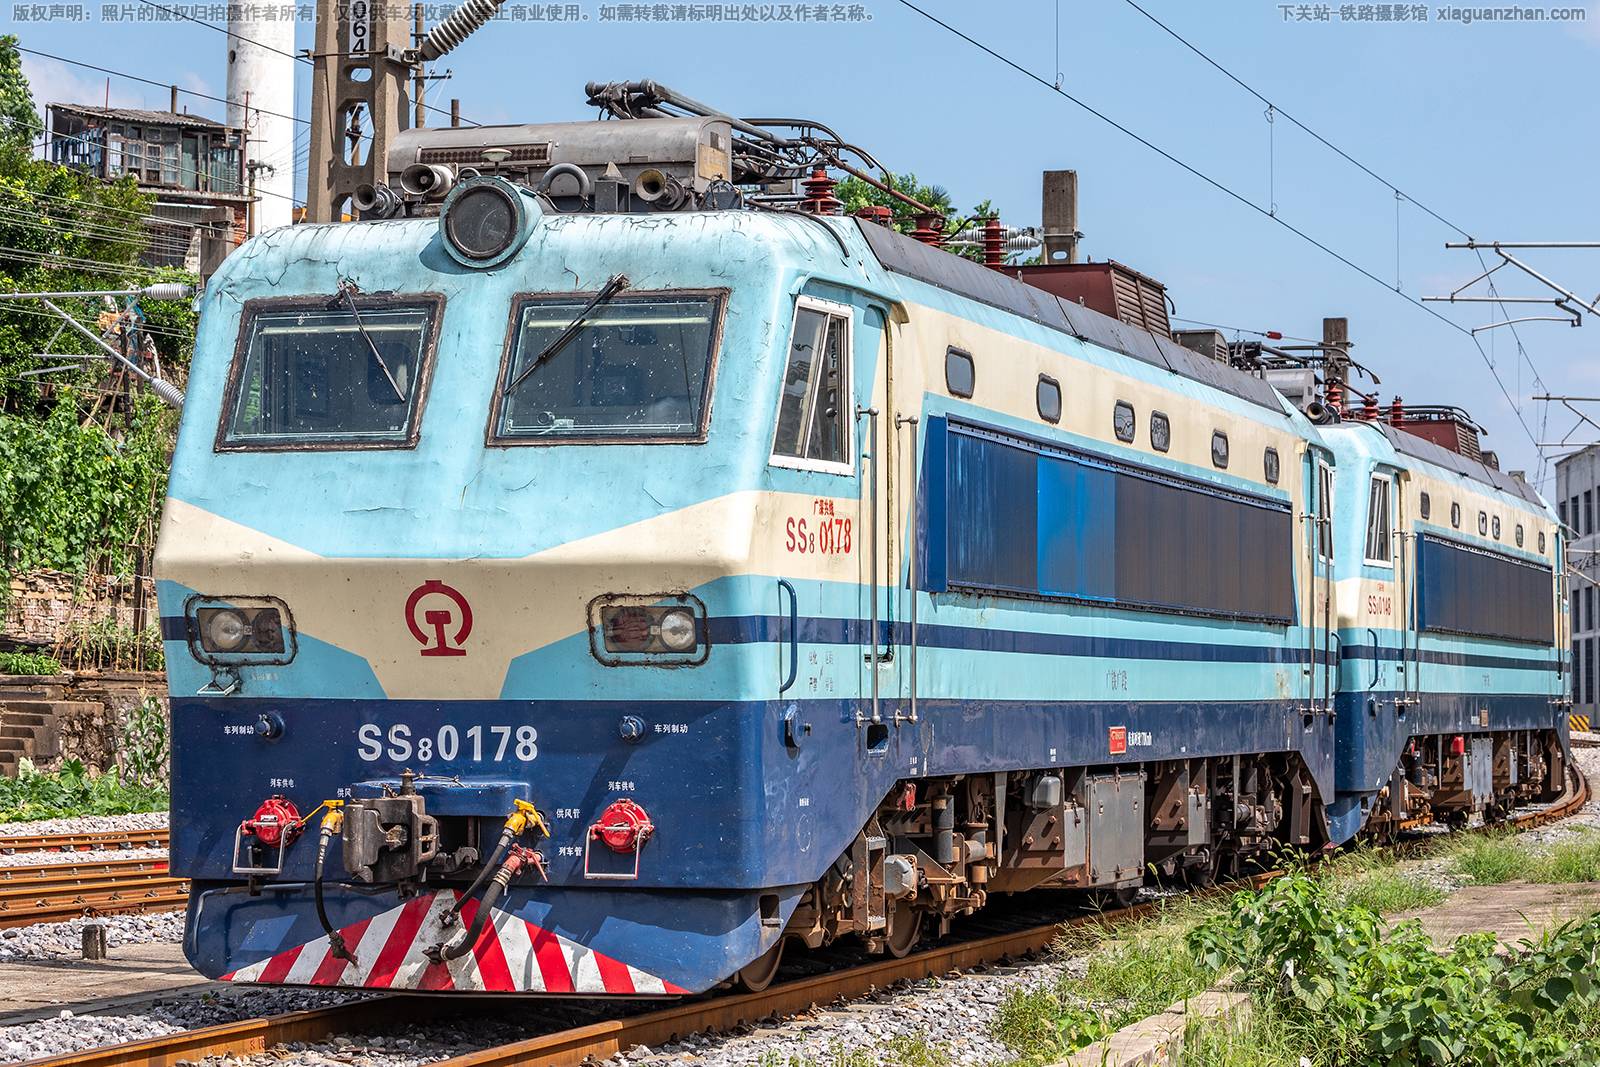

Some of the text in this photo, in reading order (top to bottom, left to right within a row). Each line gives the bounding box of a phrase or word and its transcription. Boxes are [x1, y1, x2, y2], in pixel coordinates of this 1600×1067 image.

[224, 725, 254, 735] 车列制动
[654, 723, 688, 734] 车列制动
[607, 781, 635, 791] 列车供电
[556, 808, 580, 818] 供风管
[558, 846, 582, 856] 列车管
